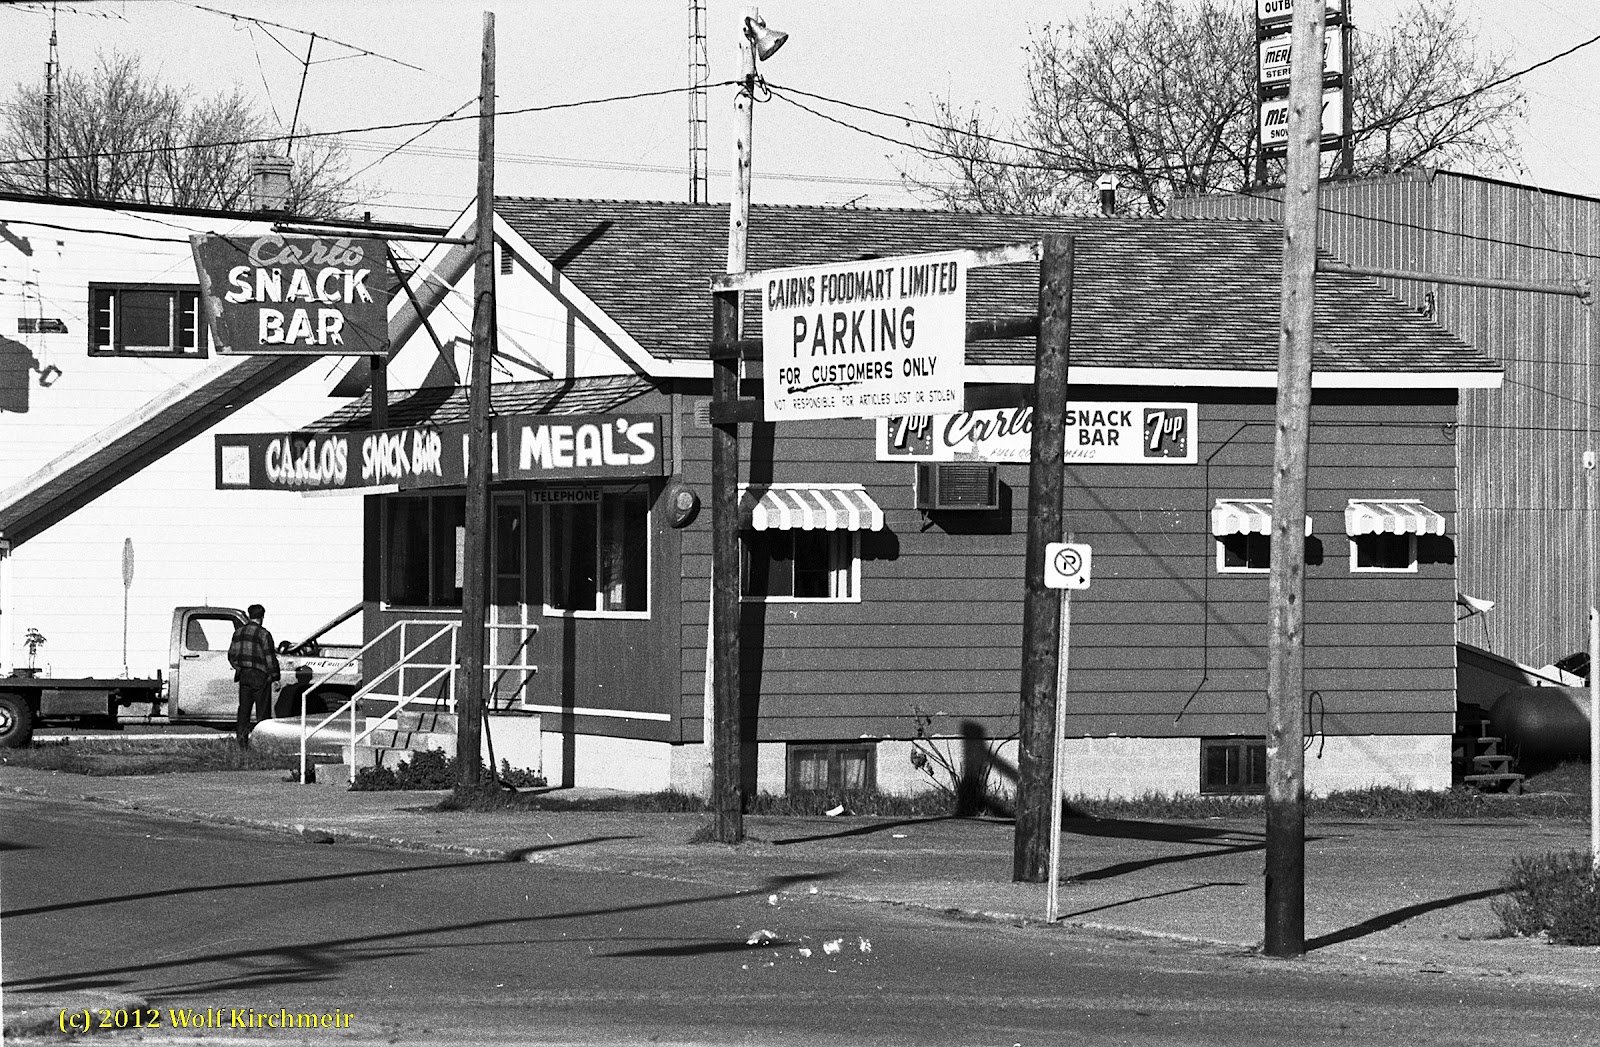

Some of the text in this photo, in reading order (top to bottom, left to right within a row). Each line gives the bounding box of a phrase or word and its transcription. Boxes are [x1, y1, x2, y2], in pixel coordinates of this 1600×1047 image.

[224, 265, 373, 304] SNACK
[768, 261, 958, 311] CAIRNS FOODMART LIMITED
[259, 308, 344, 345] BAR
[793, 305, 915, 358] PARKING
[779, 356, 937, 385] FOR CUSTOMERS ONLY
[774, 389, 956, 410] NOT RESPONSIBLE FOR ARTICLES LOST OR STOLEN
[1065, 410, 1132, 427] SNACK
[519, 417, 655, 470] MEAL'S
[1079, 429, 1119, 446] BAR
[362, 430, 411, 484] SNACK
[412, 430, 442, 476] BAR
[534, 490, 600, 502] TELEPHONE
